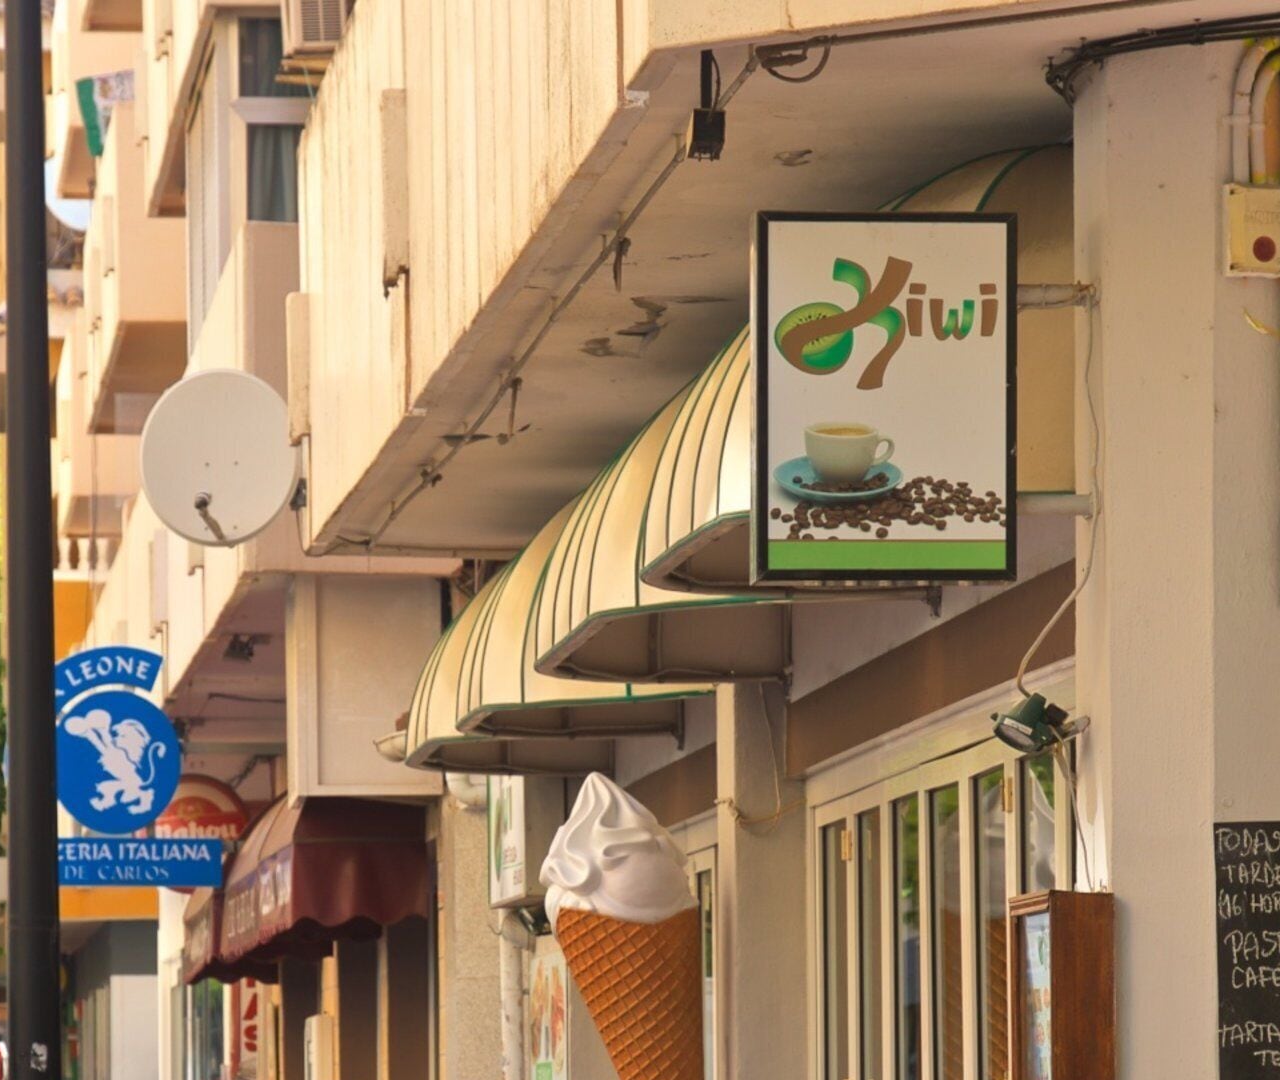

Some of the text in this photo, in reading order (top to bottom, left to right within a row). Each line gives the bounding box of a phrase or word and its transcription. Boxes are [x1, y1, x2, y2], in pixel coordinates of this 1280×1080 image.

[775, 256, 999, 390] Kiwi
[64, 655, 151, 687] LEONE
[118, 843, 211, 861] ITALIANA
[64, 864, 170, 881] DE CARLOS
